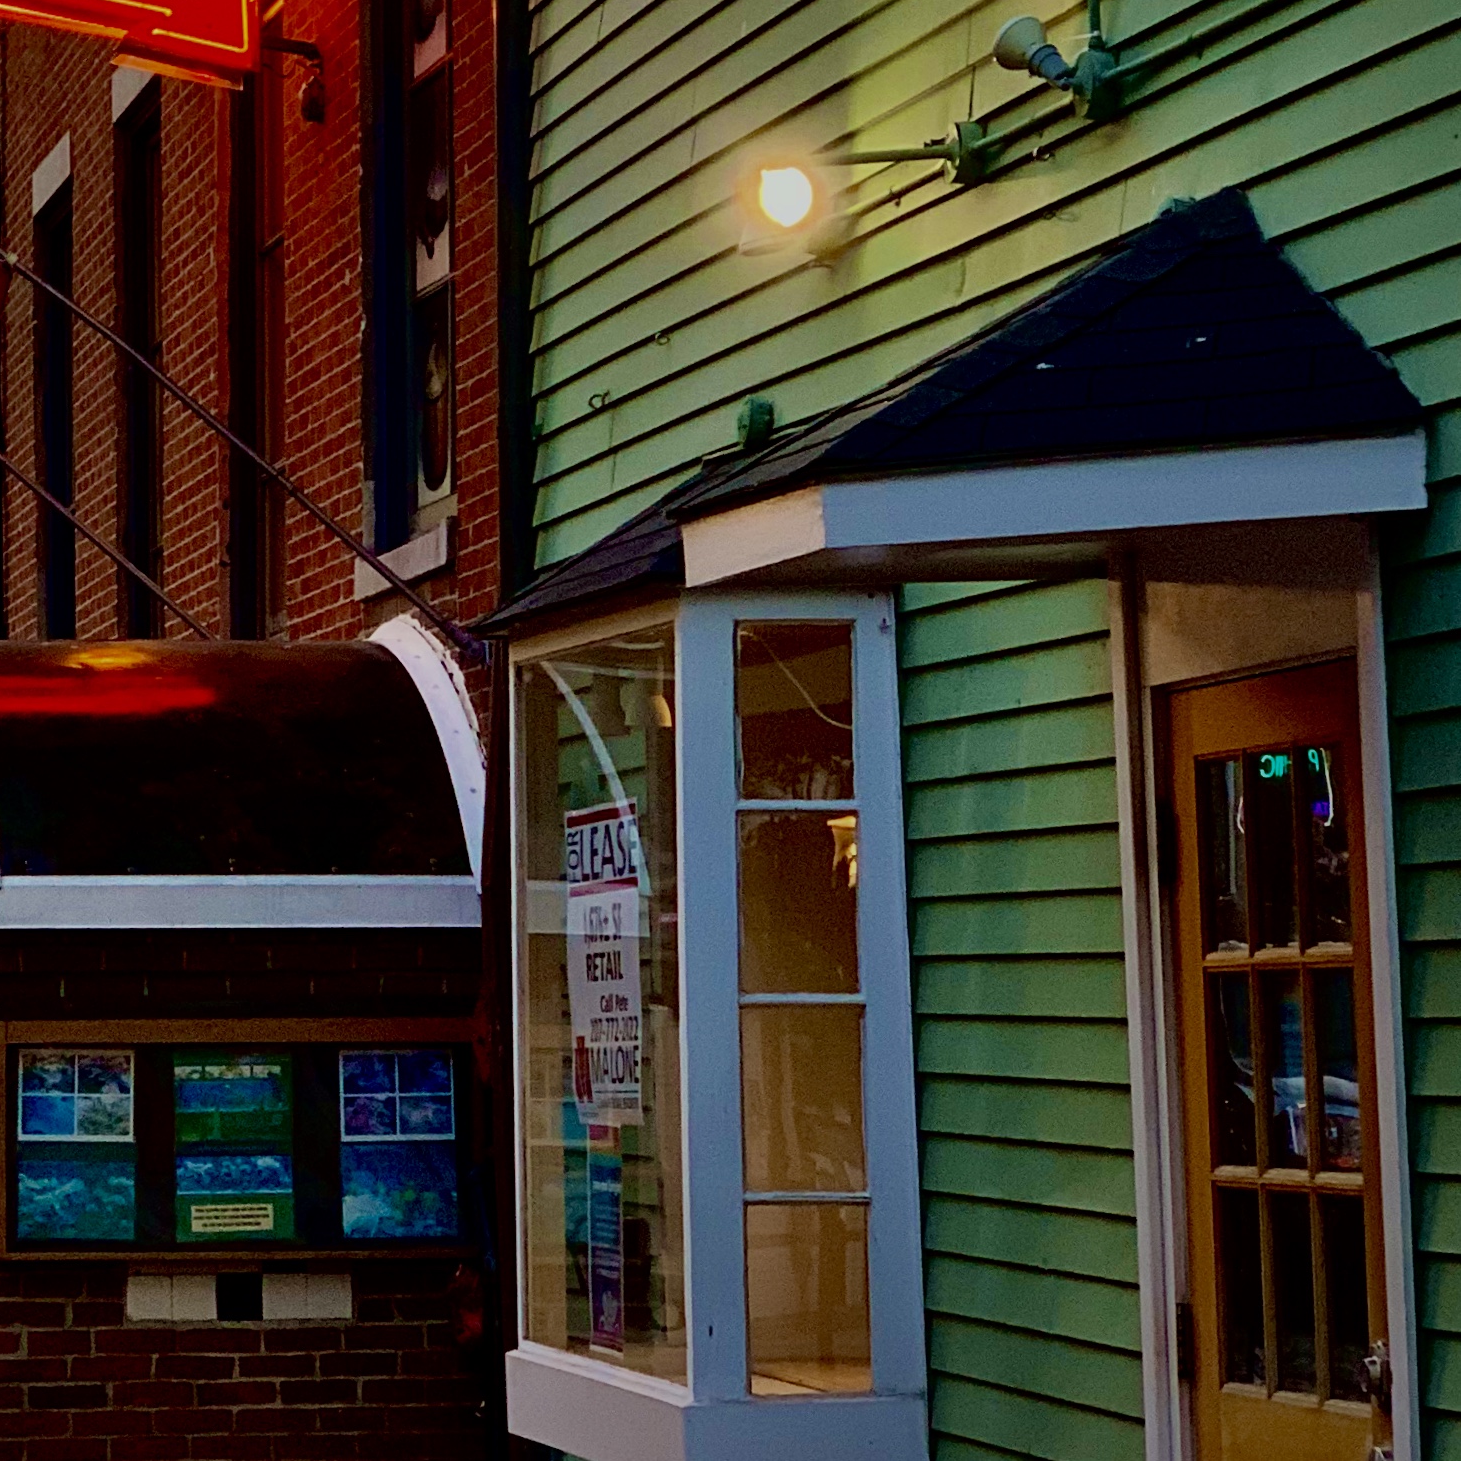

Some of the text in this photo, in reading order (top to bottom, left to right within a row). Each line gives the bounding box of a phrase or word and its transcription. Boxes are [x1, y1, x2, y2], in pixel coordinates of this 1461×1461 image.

[567, 830, 580, 883] FOR
[579, 820, 637, 881] LEASE
[586, 950, 624, 982] RETAIL
[600, 994, 614, 1013] Call
[591, 1045, 639, 1084] MALONE
